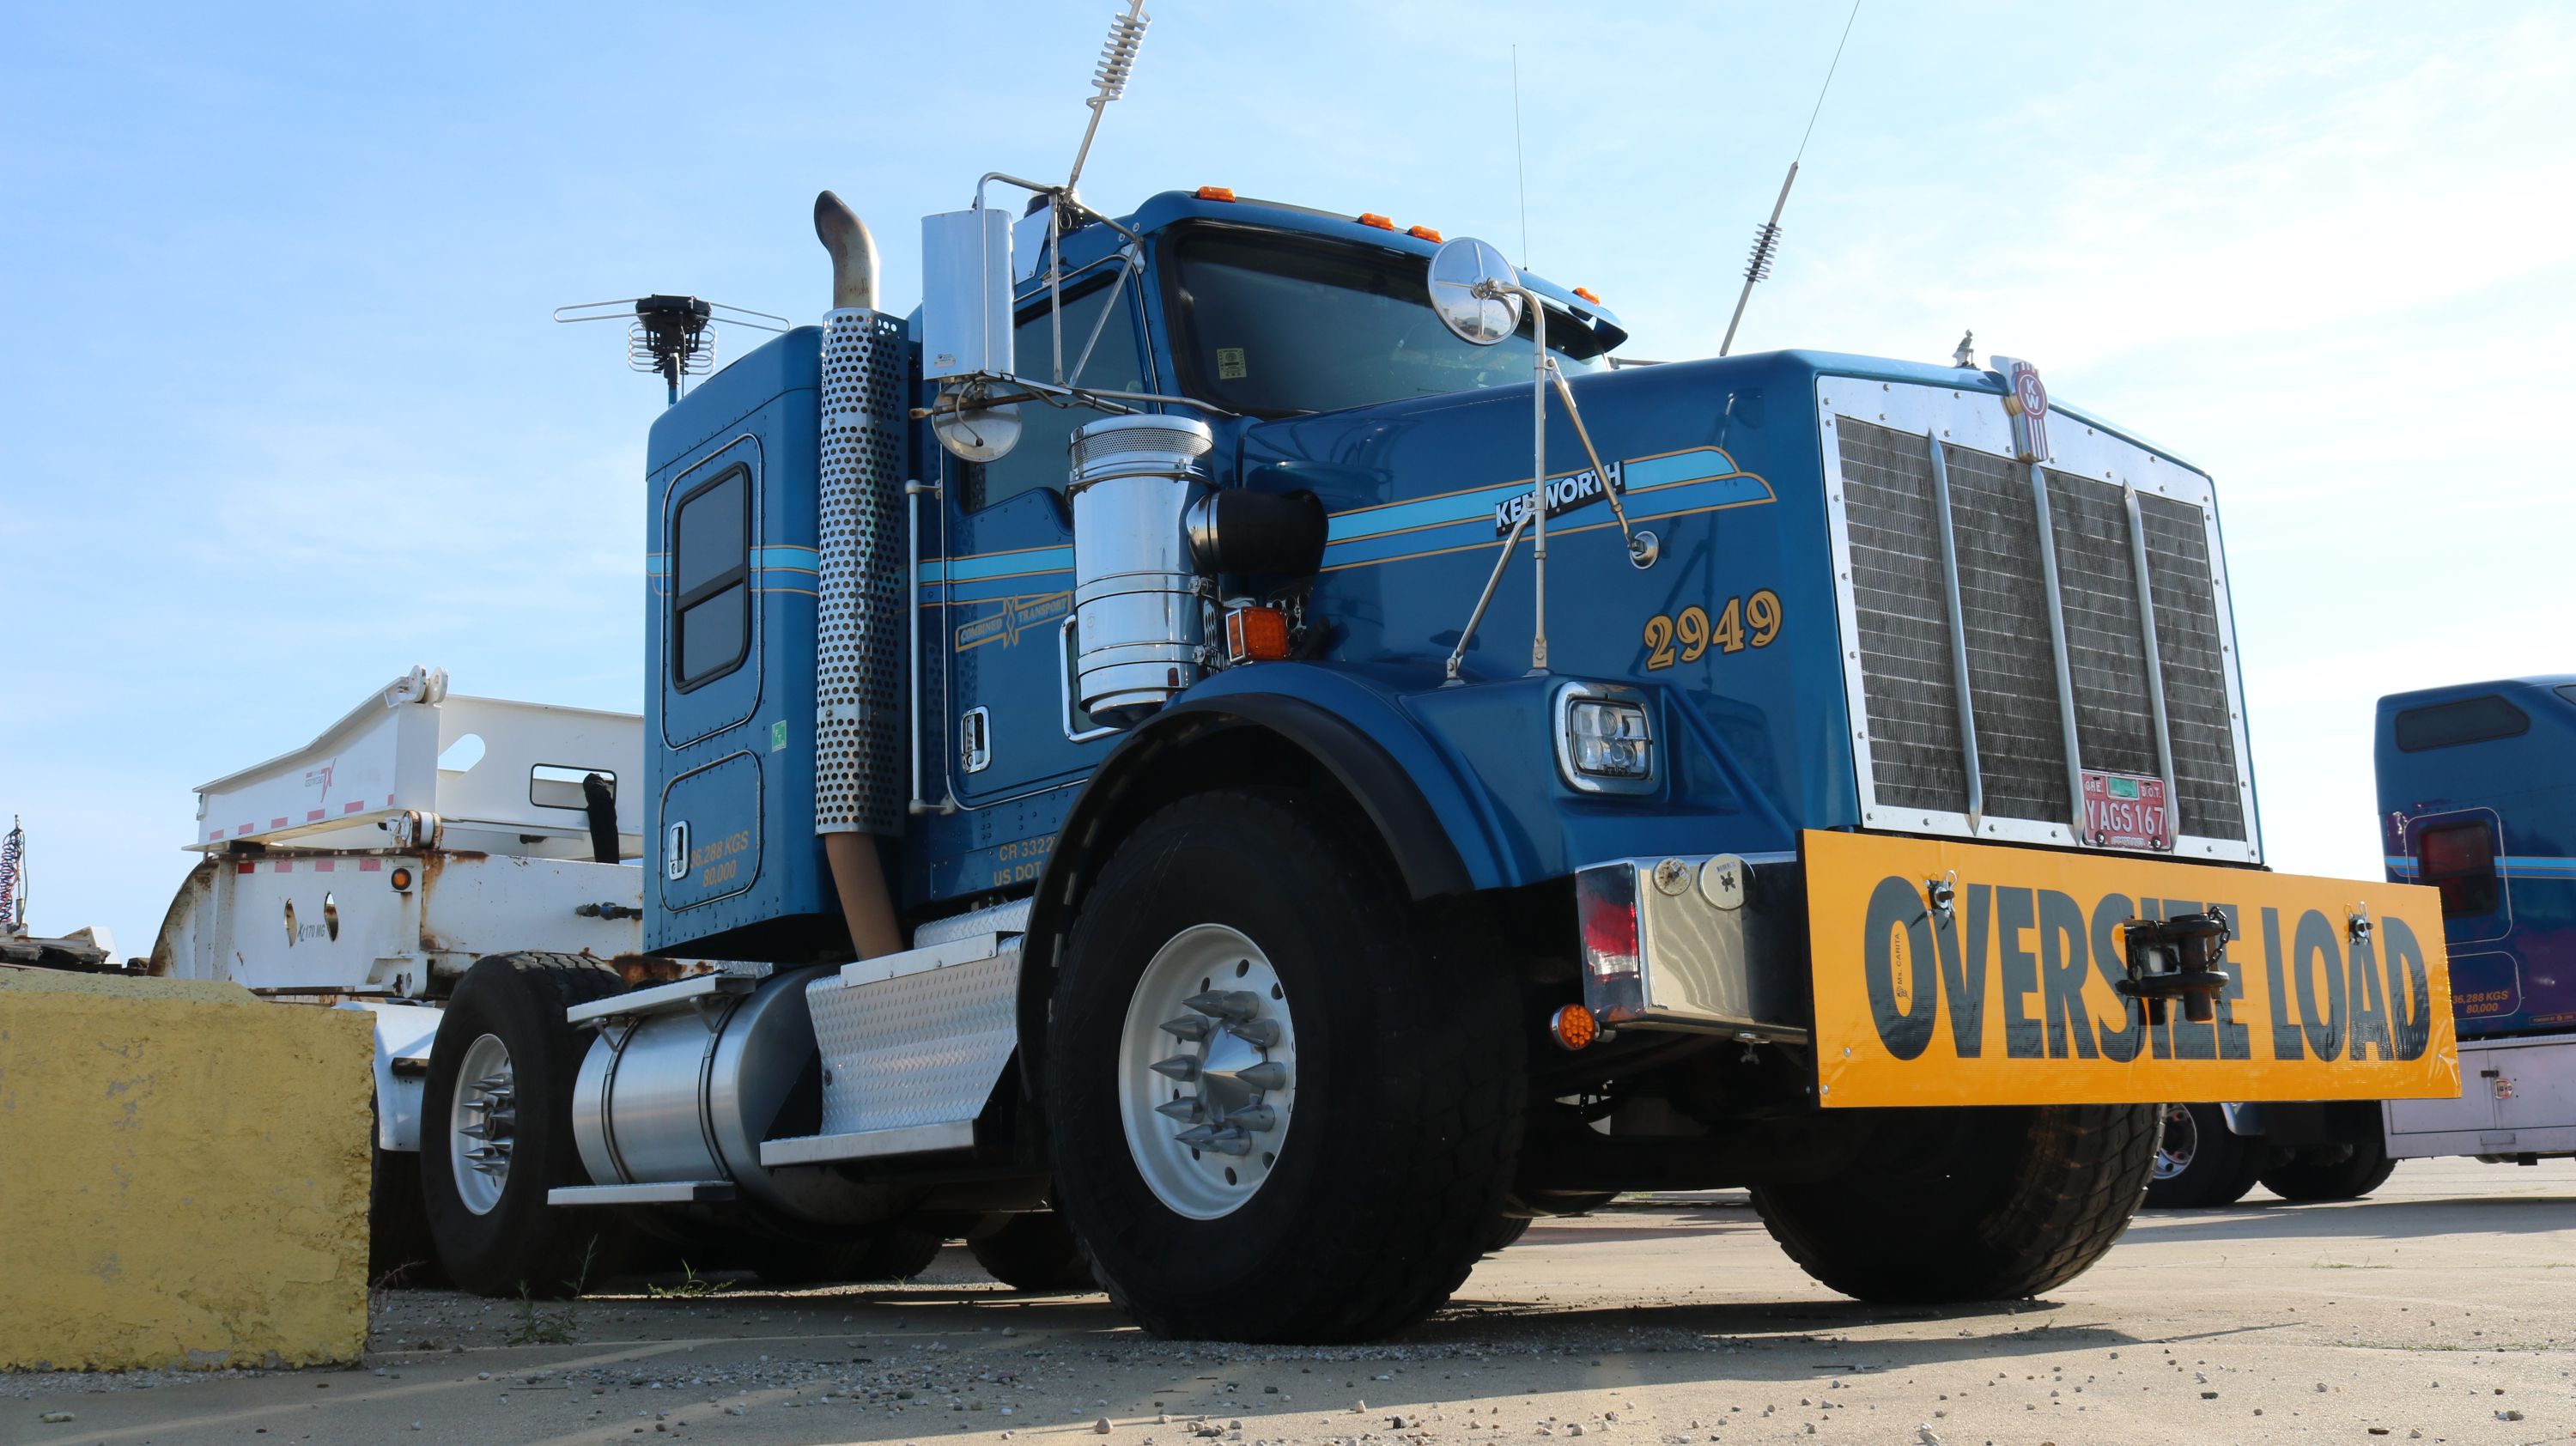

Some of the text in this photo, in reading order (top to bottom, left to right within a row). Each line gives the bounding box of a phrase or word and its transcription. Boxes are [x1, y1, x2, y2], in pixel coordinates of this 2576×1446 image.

[960, 597, 1066, 644] COMBINED TRANSPORT
[1643, 588, 1783, 672] 2949
[724, 829, 750, 857] KGS
[999, 843, 1018, 861] CR
[993, 860, 1042, 887] US DOT
[2261, 907, 2430, 1062] LOAD
[2485, 990, 2508, 1001] KGS
